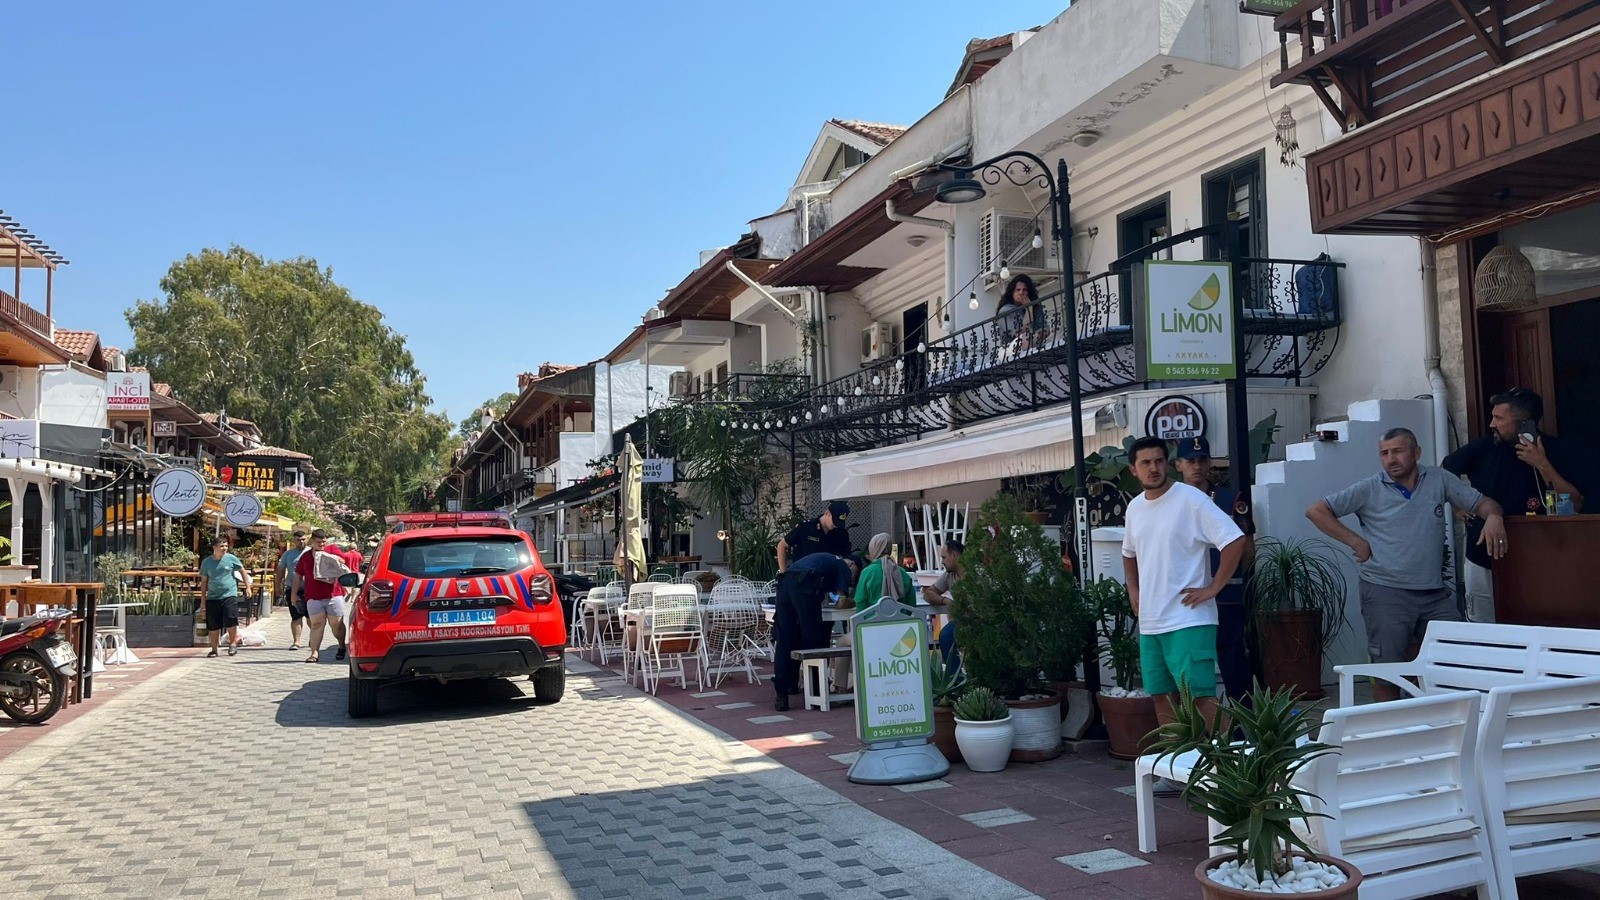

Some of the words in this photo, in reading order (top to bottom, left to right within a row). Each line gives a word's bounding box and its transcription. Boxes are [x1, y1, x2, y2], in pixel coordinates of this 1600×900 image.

[1165, 367, 1171, 375] 0
[1172, 367, 1185, 375] 545
[1187, 367, 1199, 375] 566
[1200, 367, 1210, 375] 96
[1211, 367, 1220, 375] 22
[1157, 407, 1194, 439] poi
[237, 467, 275, 478] HATAY
[430, 598, 497, 606] DUSTER
[436, 612, 449, 623] 48
[453, 611, 471, 622] JAA
[476, 611, 494, 620] 104
[394, 630, 432, 640] JANDARMA
[877, 705, 895, 715] BOŞ
[897, 703, 915, 712] ODA
